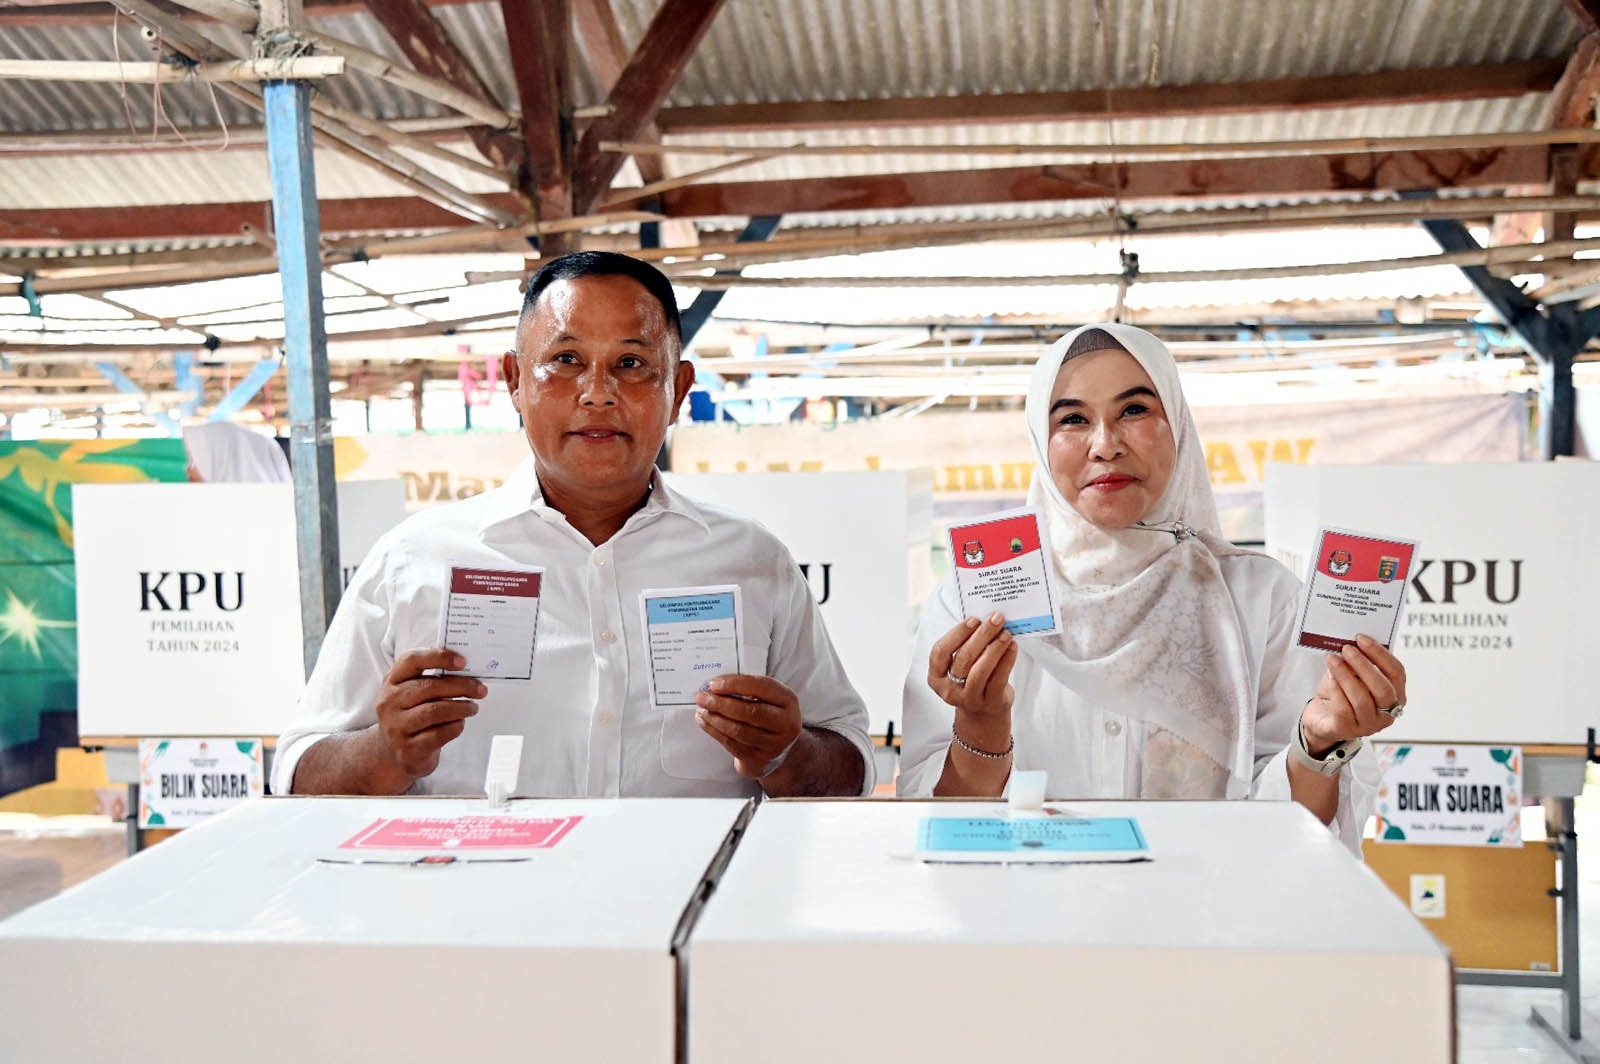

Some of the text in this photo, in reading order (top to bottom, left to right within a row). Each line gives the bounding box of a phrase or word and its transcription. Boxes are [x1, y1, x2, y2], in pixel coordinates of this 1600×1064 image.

[978, 566, 1022, 578] SURAT SUARA
[139, 571, 245, 611] KPU
[1335, 584, 1381, 596] SURAT SUARA
[151, 620, 235, 633] PEMILIHAN
[1407, 613, 1508, 627] PEMILIHAN
[147, 640, 240, 652] TAHUN 2024
[1402, 635, 1513, 649] TAHUN 2024
[161, 773, 248, 799] BILIK SUARA
[1397, 783, 1504, 814] BILIK SUARA
